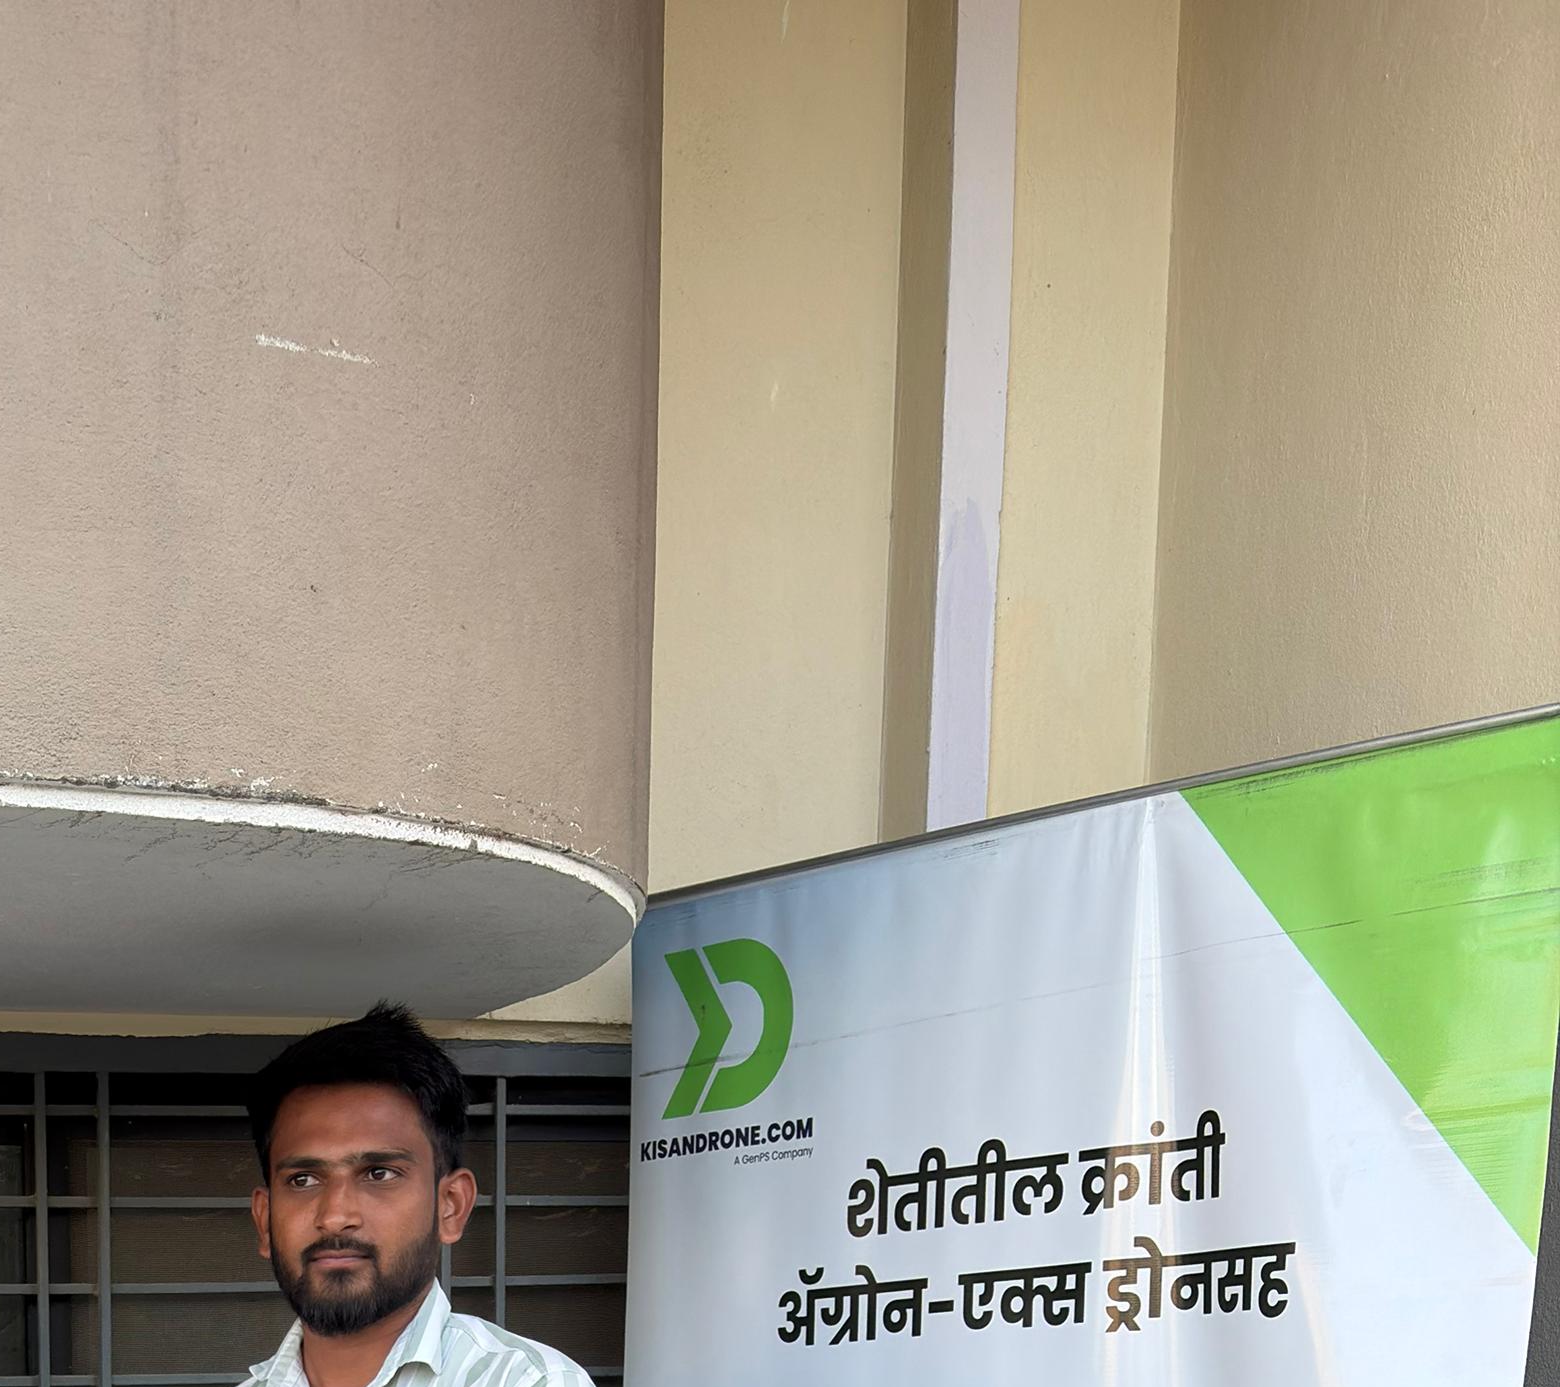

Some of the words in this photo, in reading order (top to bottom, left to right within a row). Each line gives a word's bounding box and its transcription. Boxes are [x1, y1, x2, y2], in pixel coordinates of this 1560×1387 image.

[640, 1117, 814, 1162] KISANDRONE.COM
[733, 1155, 741, 1166] A
[742, 1151, 770, 1165] GenPS
[772, 1146, 815, 1161] Company
[846, 1138, 1069, 1238] शेतीतील
[1080, 1110, 1227, 1216] क्रांती
[1103, 1236, 1297, 1333] ड्रोनसह
